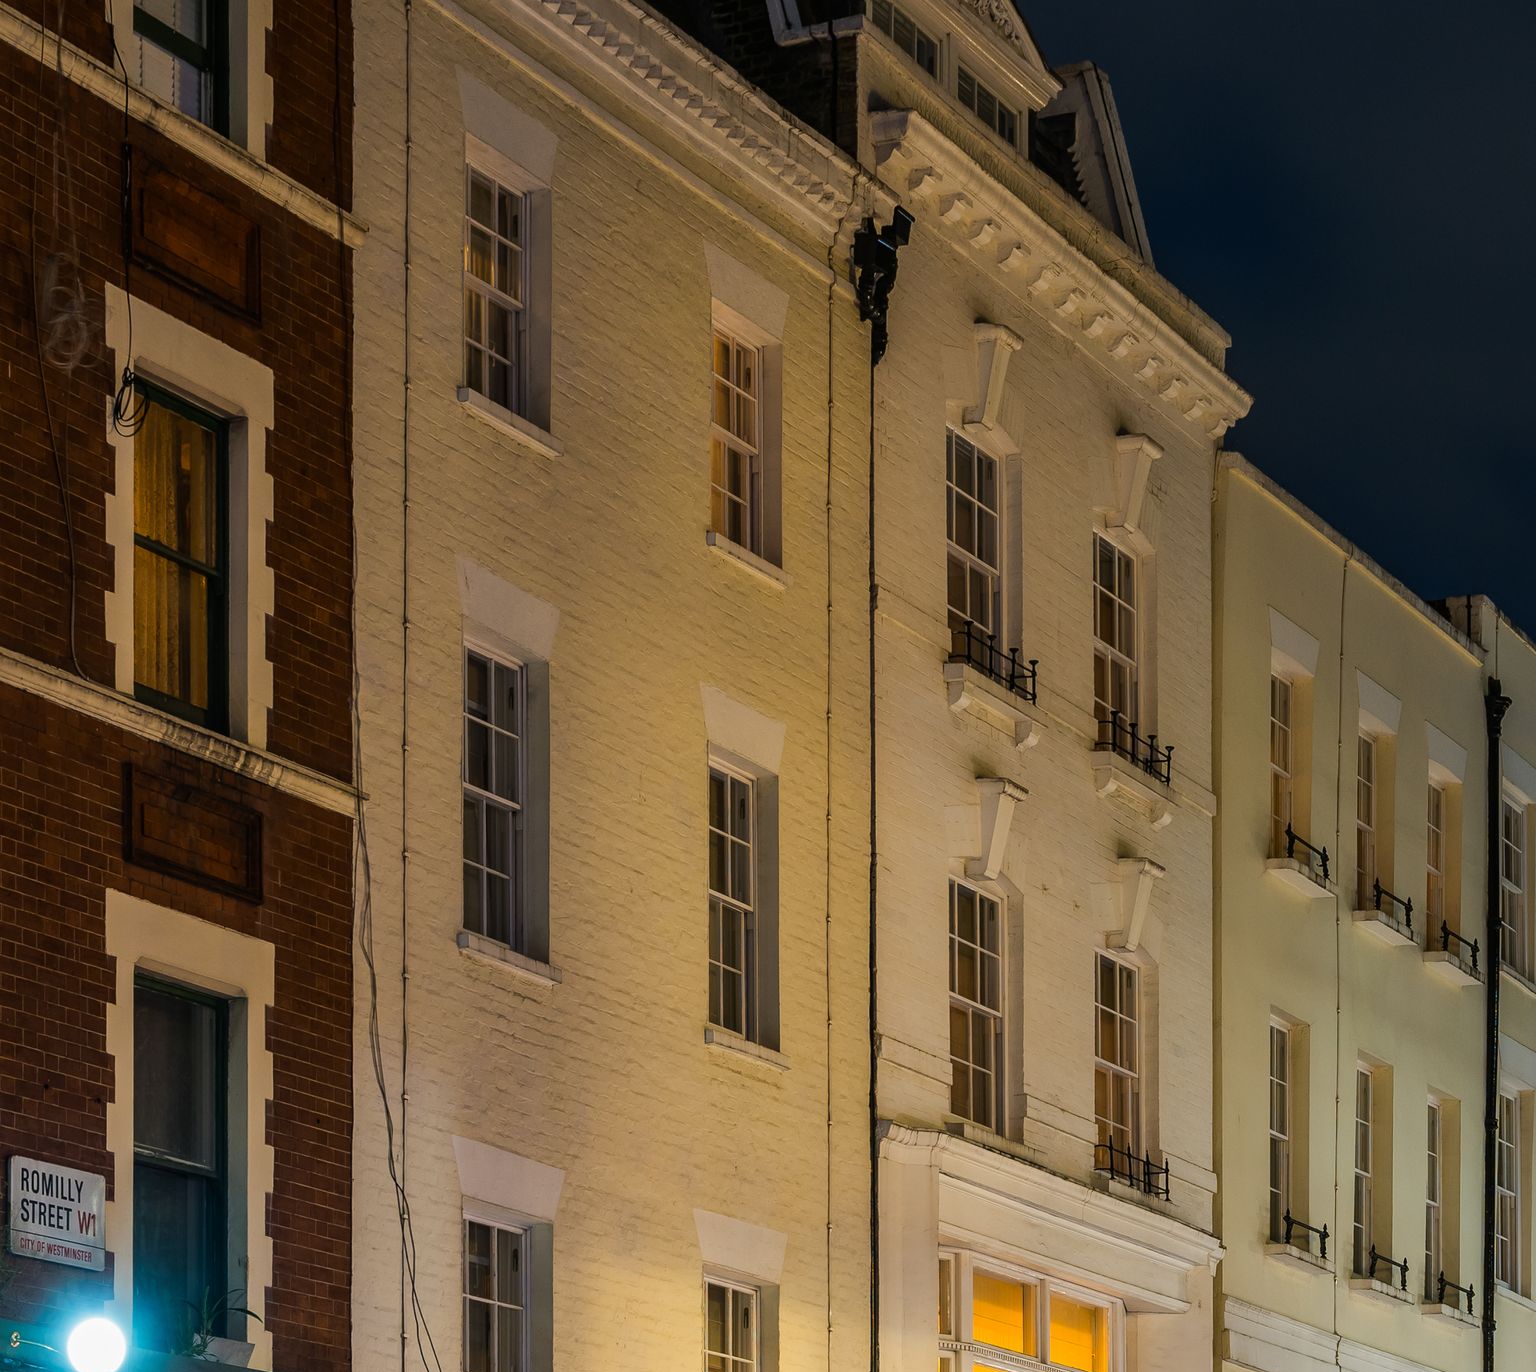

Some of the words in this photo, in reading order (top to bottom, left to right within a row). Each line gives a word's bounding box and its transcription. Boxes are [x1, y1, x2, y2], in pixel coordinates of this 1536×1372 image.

[21, 1167, 84, 1203] ROMILLY
[20, 1198, 72, 1231] STREET
[77, 1210, 96, 1237] W1
[20, 1237, 35, 1250] CITY
[37, 1240, 45, 1252] OF
[47, 1243, 92, 1263] WESTMINSTER
